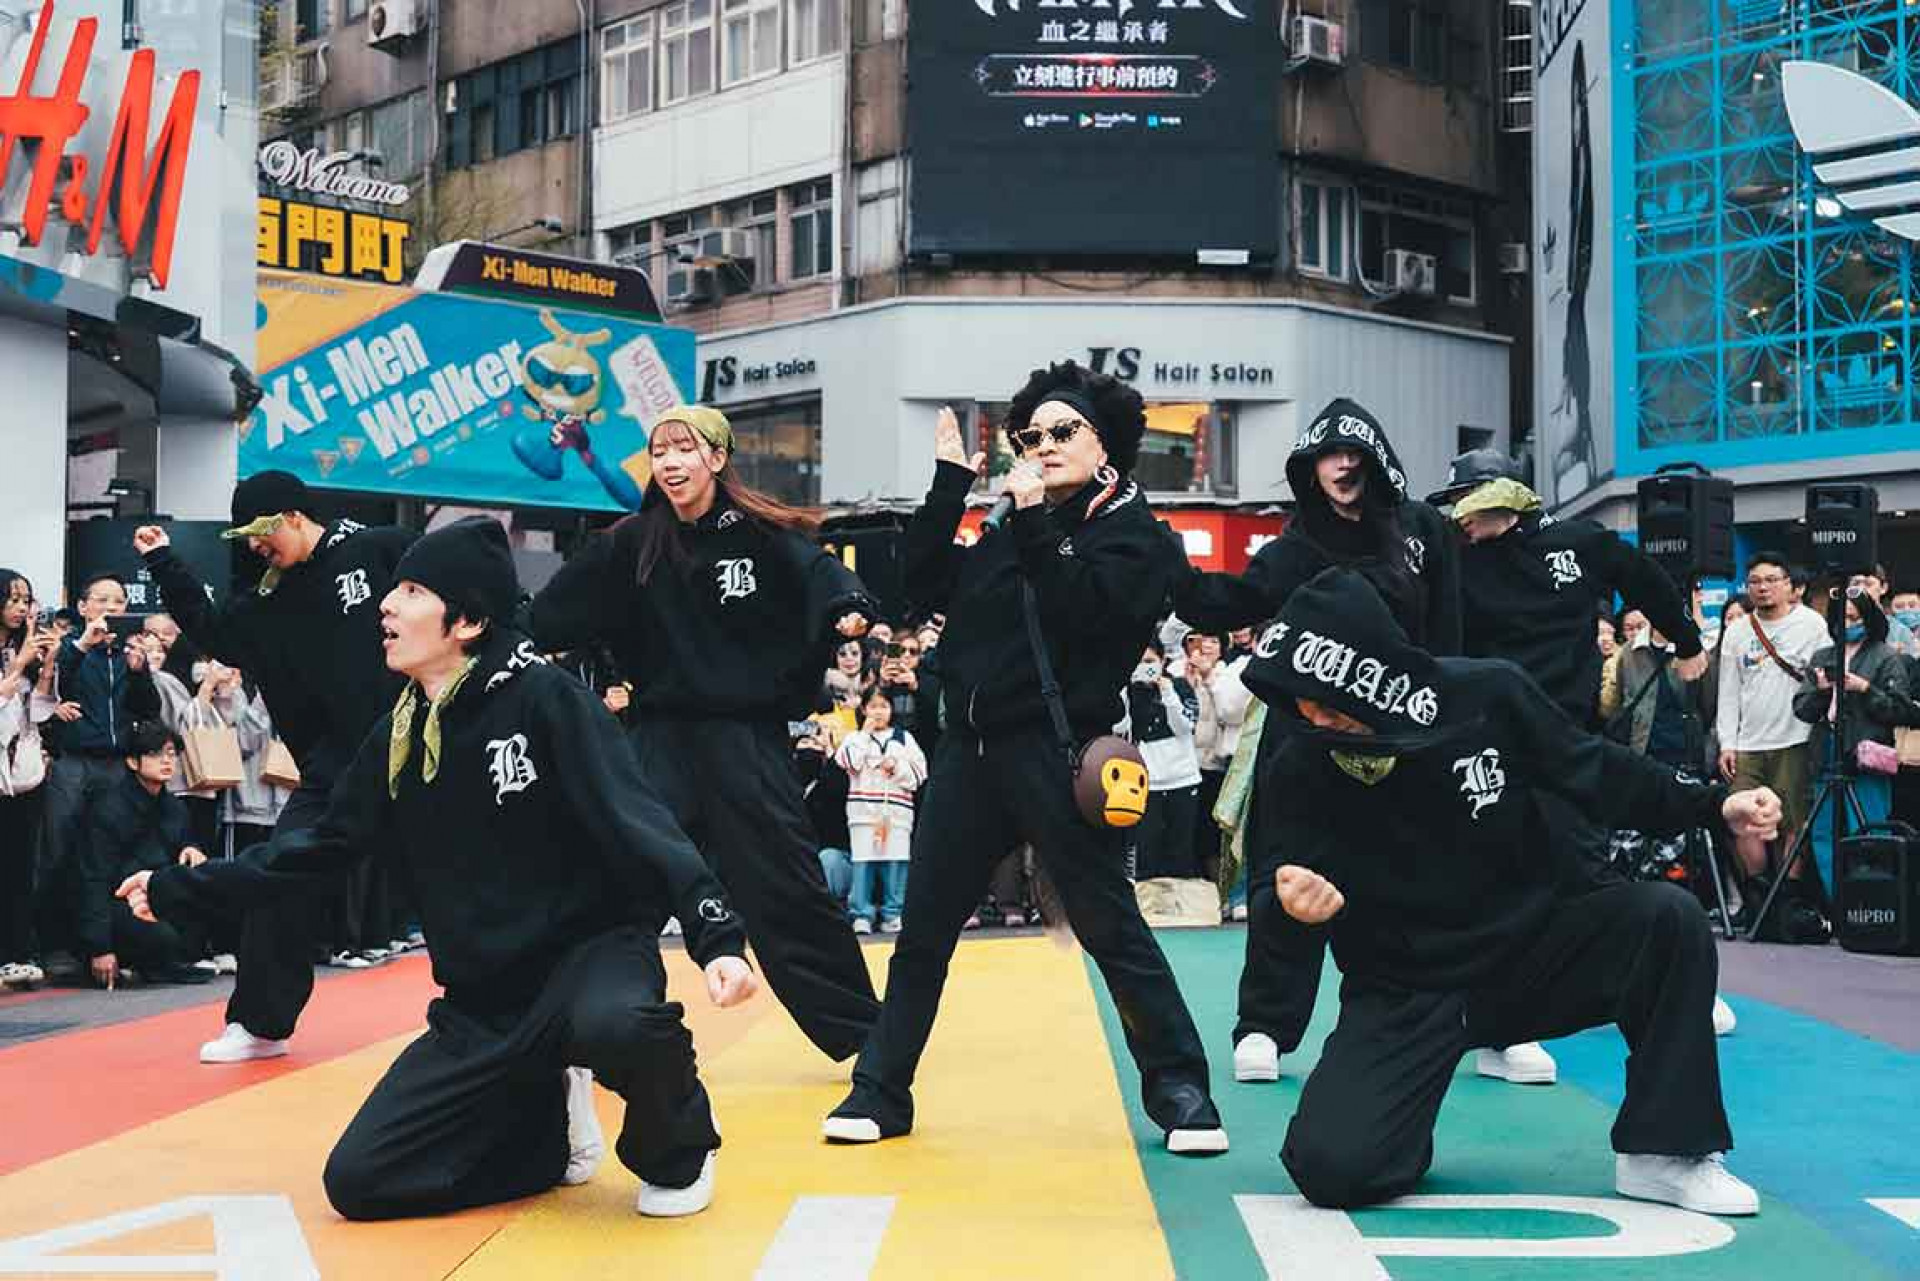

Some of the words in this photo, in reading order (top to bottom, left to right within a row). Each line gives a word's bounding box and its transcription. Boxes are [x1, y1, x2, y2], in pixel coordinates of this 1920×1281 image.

[0, 0, 201, 291] H&M
[261, 139, 410, 205] Welcome
[482, 255, 548, 287] Xi-Men
[551, 267, 617, 297] Walker
[259, 322, 430, 450] Xi-Men
[356, 339, 526, 460] Walker
[743, 365, 771, 384] Hair
[775, 358, 816, 377] Salon
[1154, 362, 1200, 382] Hair
[1211, 362, 1274, 384] Salon
[334, 568, 372, 615] B
[714, 557, 757, 605] B
[1292, 630, 1438, 726] WANG
[485, 733, 539, 806] B
